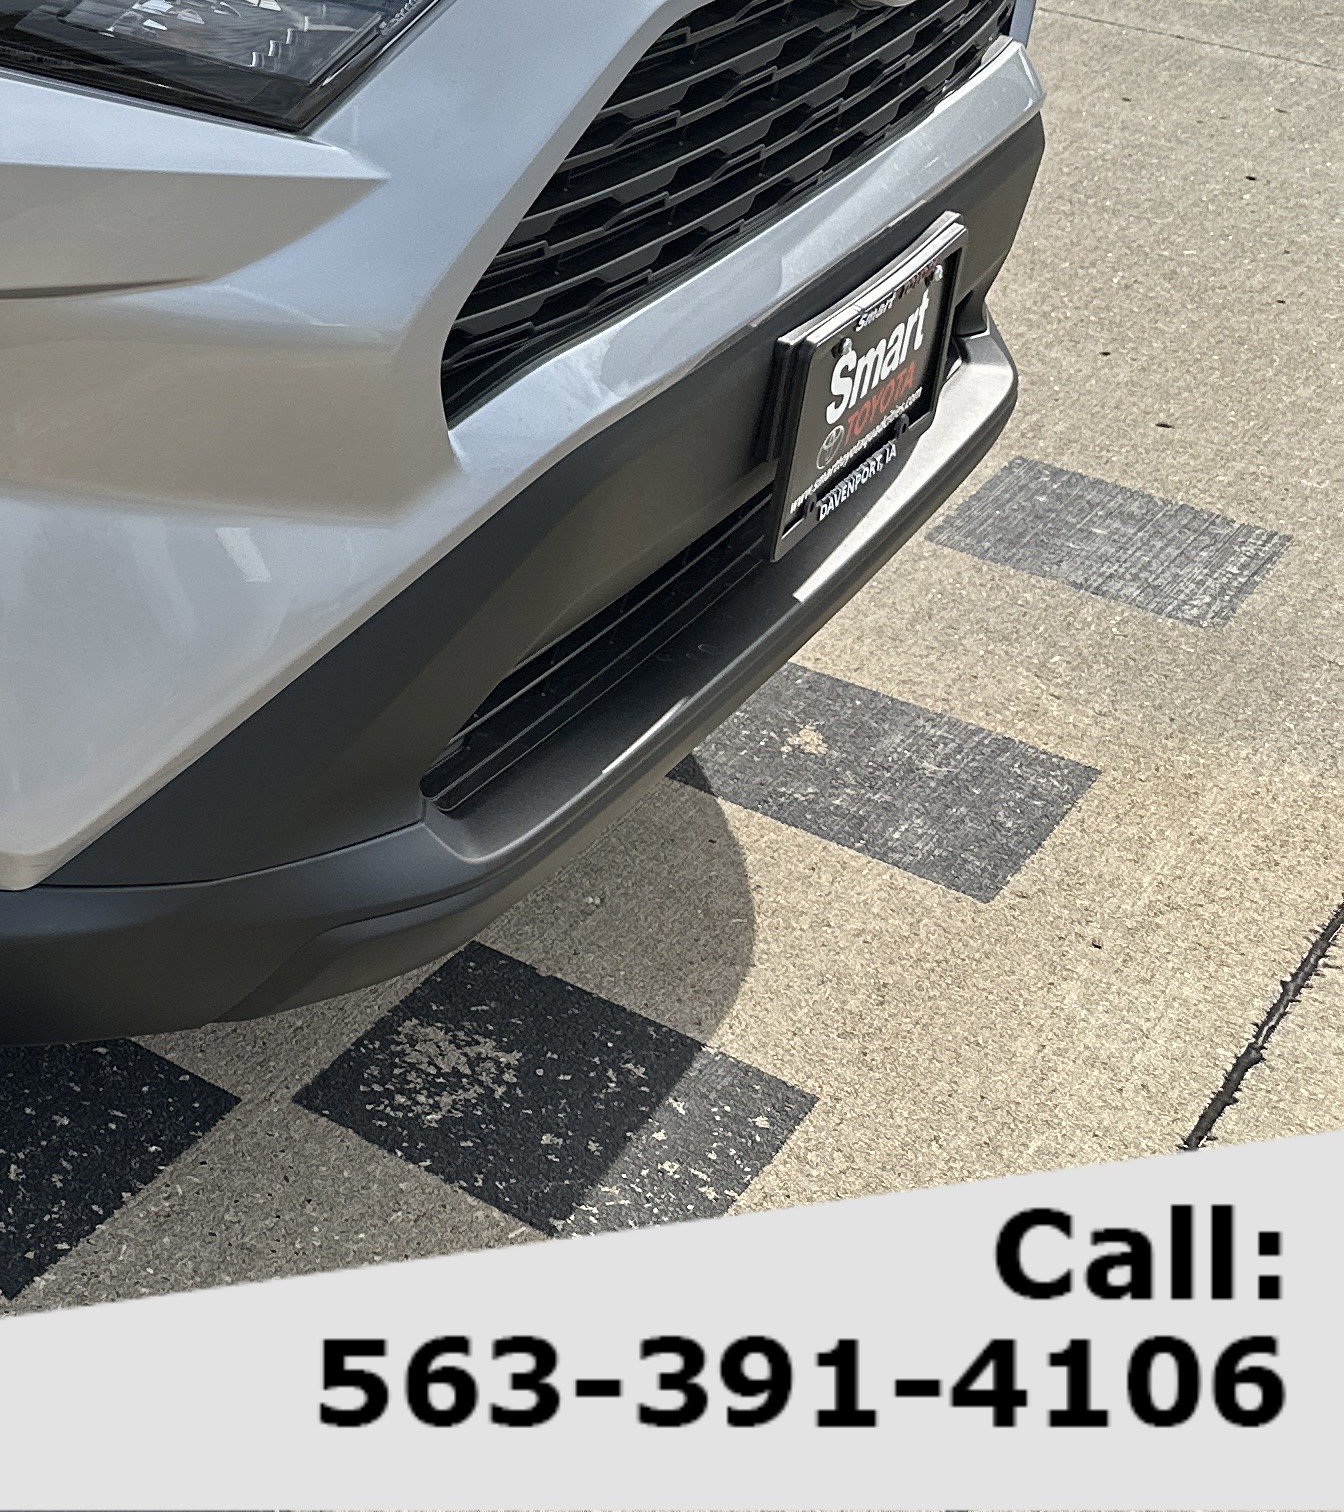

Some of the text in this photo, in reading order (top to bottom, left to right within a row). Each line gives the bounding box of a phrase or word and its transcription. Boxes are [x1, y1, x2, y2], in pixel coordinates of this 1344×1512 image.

[856, 290, 897, 333] Smart
[826, 288, 930, 425] Smart
[845, 361, 917, 446] TOYOTA
[885, 442, 897, 465] IA
